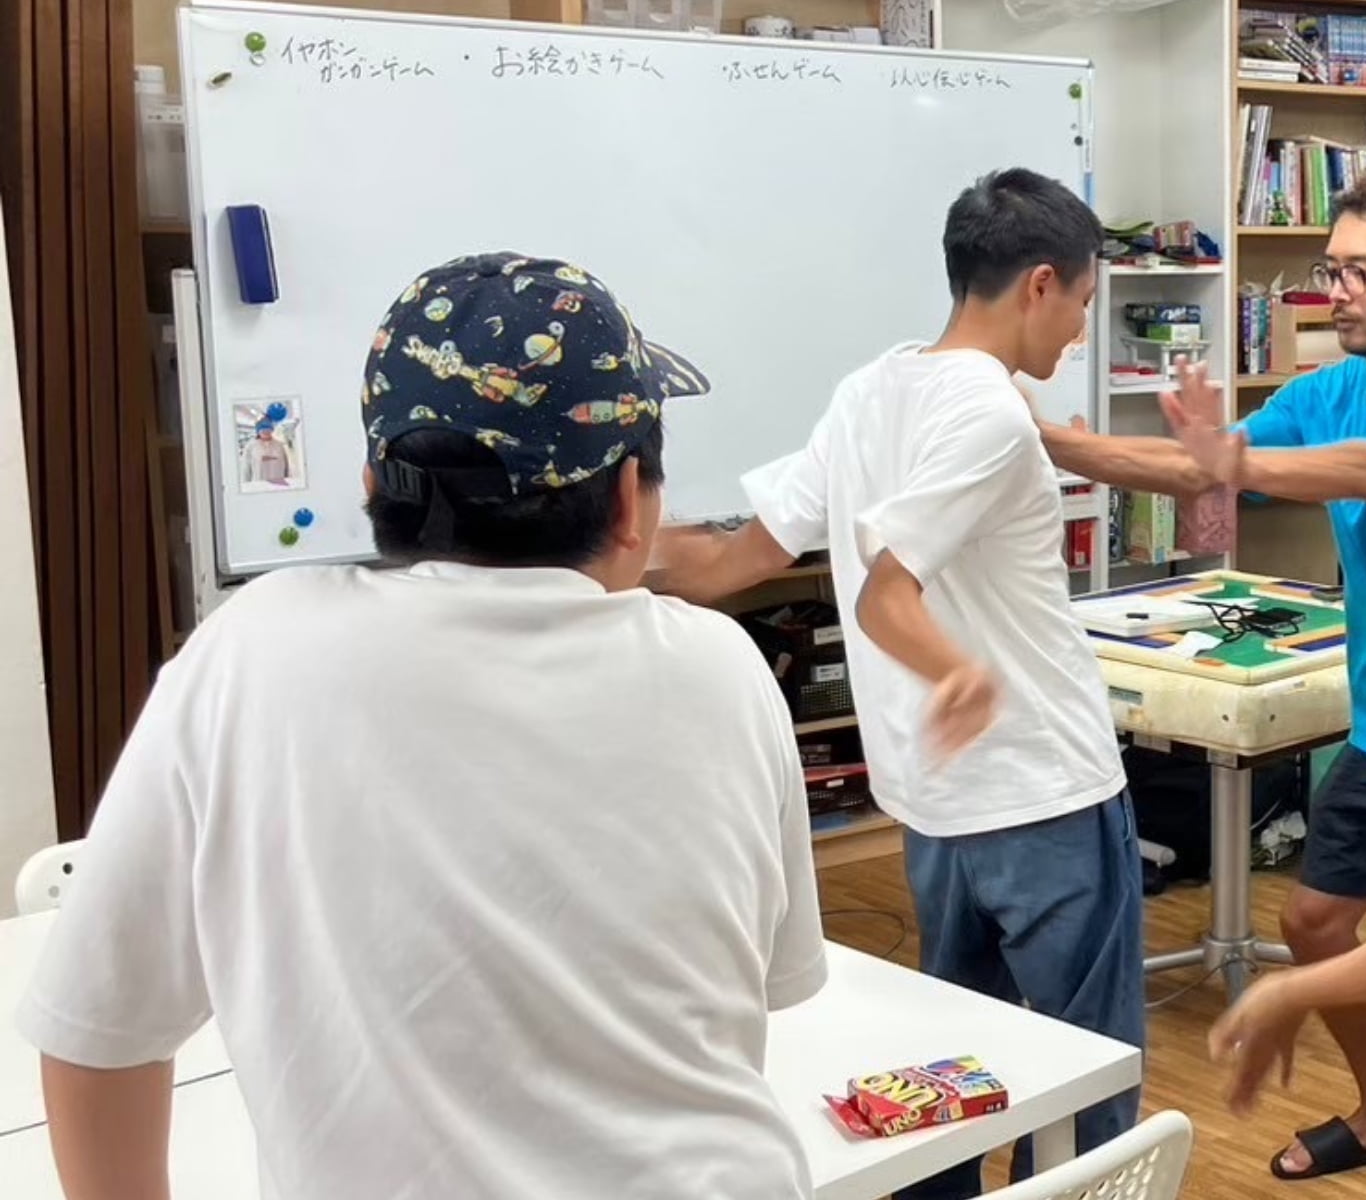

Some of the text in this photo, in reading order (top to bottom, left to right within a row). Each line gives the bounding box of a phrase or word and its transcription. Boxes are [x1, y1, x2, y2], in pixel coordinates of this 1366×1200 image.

[281, 37, 356, 64] イヤホン
[852, 1071, 944, 1109] UNO
[883, 1109, 921, 1136] UNO
